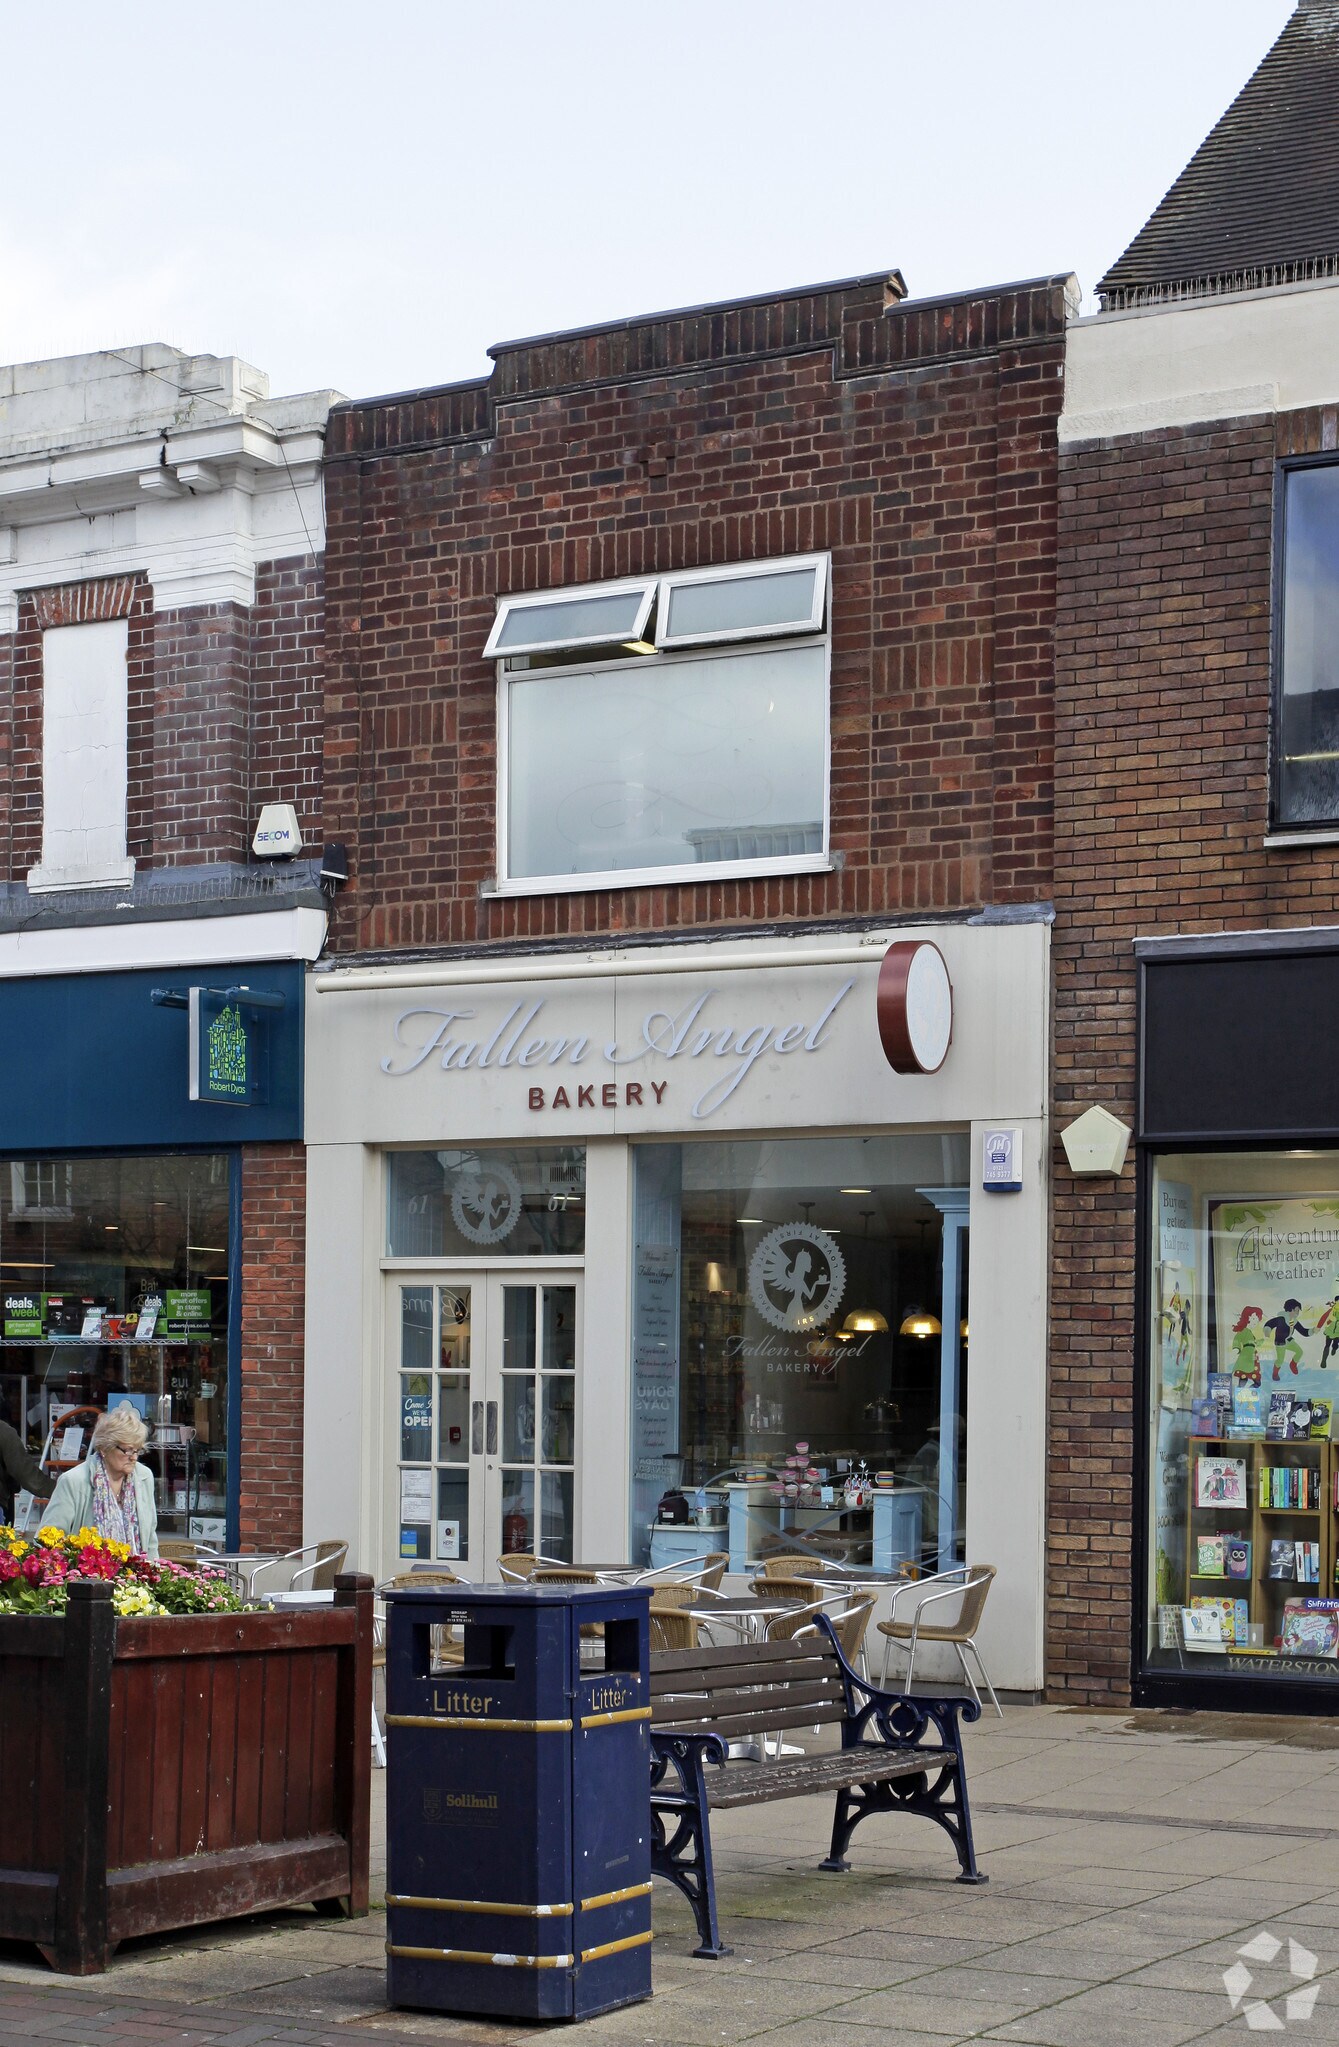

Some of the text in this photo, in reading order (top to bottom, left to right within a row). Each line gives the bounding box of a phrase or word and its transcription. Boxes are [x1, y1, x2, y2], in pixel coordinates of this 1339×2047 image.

[257, 830, 290, 842] SECOM
[380, 976, 858, 1119] Fallen Angel
[209, 1080, 246, 1094] Robert Dyas
[527, 1079, 669, 1111] BAKERY
[407, 1194, 429, 1215] 61
[547, 1192, 570, 1212] 61
[1162, 1192, 1177, 1213] Buy
[1263, 1248, 1333, 1263] whatever
[1263, 1264, 1326, 1280] weather
[5, 1296, 33, 1309] deals
[145, 1295, 162, 1307] deals
[170, 1297, 188, 1305] great
[823, 1286, 839, 1310] BITE
[11, 1306, 40, 1317] week
[721, 1334, 873, 1375] Fallen Angel
[766, 1363, 820, 1373] BAKERY
[404, 1398, 425, 1411] Come
[1203, 1460, 1241, 1470] Parents
[433, 1689, 493, 1714] Litter
[591, 1688, 627, 1711] Litter
[446, 1794, 498, 1809] Solihull
